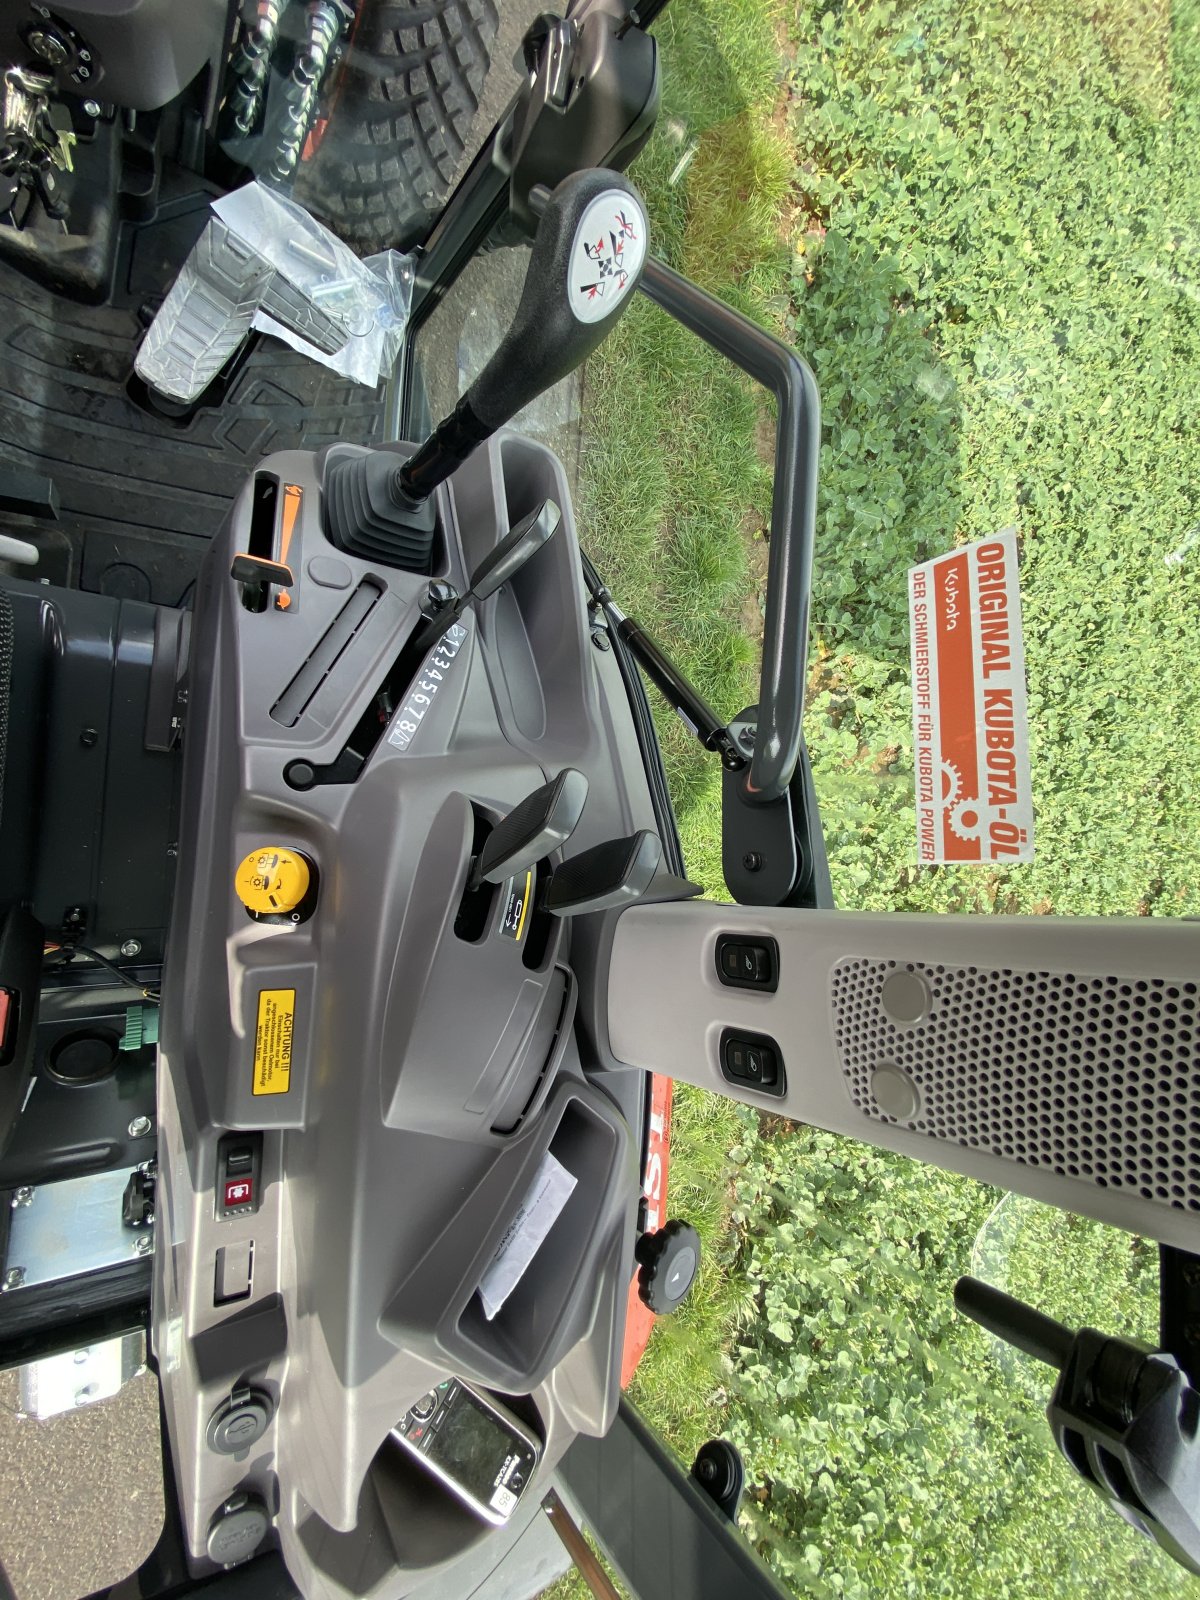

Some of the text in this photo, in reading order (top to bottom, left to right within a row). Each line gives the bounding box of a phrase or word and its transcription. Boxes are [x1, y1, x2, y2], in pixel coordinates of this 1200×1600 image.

[944, 568, 960, 631] Kubota
[440, 645, 456, 658] 2
[435, 657, 449, 669] 3
[428, 669, 443, 680] 4
[421, 680, 438, 693] 5
[414, 693, 430, 705] 6
[976, 543, 1028, 861] ORIGINAL KUBOTA-ÖL
[408, 707, 425, 720] 7
[913, 572, 935, 861] DER SCHMIERSTOFF FÜR KUBOTA POWER
[400, 720, 416, 732] 8
[282, 1012, 292, 1060] ACHTUNG
[260, 1056, 268, 1087] beschädigt
[498, 1492, 511, 1508] 85
